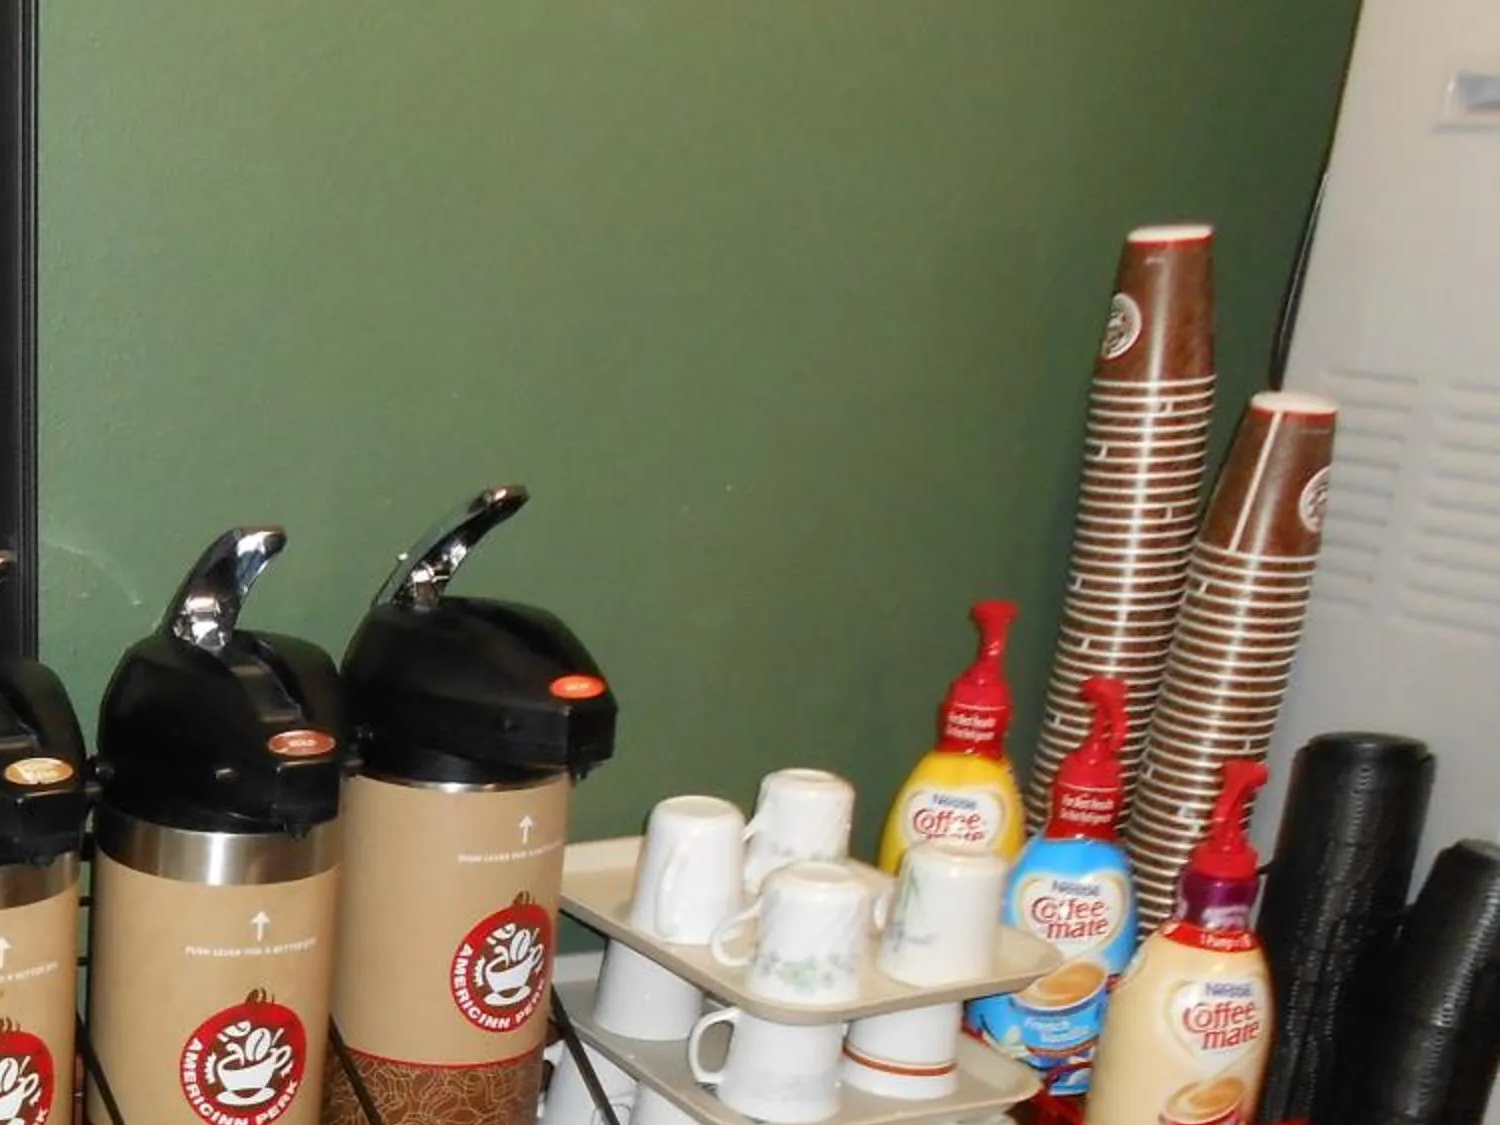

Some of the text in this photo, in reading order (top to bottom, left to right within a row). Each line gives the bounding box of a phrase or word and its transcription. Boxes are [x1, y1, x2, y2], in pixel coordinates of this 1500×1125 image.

[1046, 918, 1109, 939] mate
[454, 943, 511, 1029] AMERICINN
[1183, 1001, 1256, 1034] Coffee
[1202, 1021, 1260, 1050] mate
